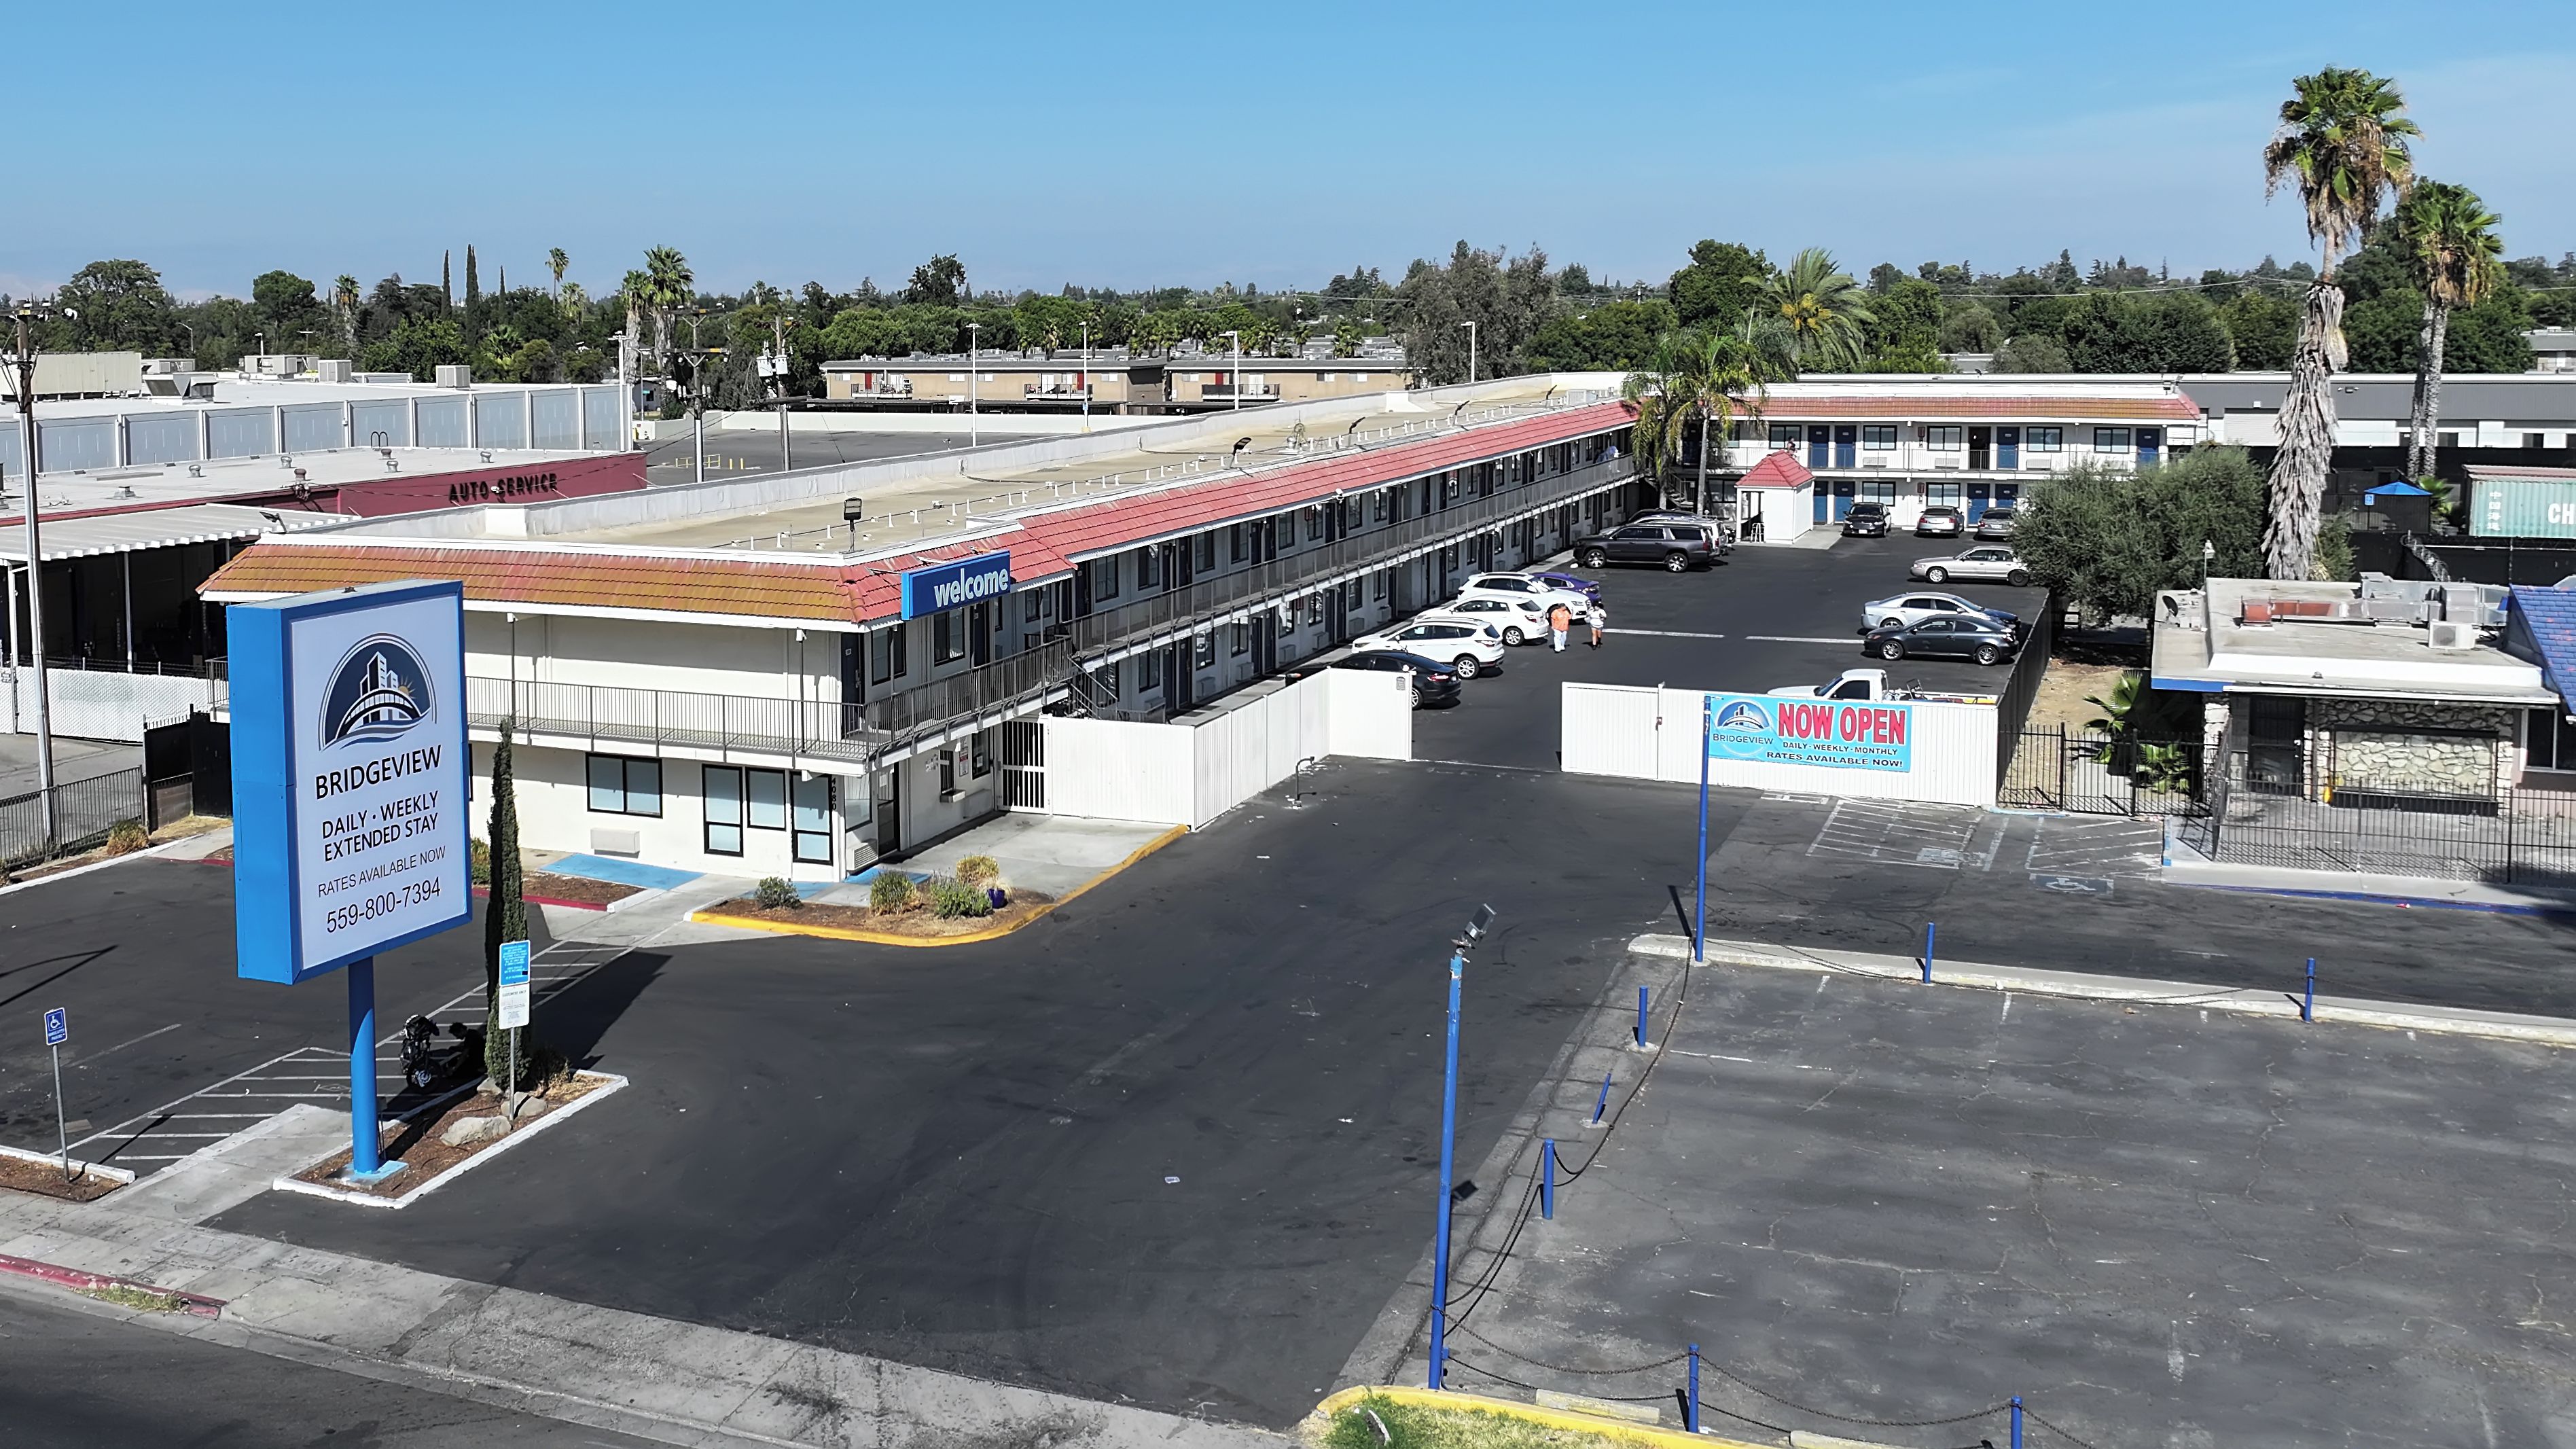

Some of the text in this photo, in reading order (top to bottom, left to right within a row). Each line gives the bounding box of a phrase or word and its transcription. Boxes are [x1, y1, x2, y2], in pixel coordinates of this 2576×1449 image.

[449, 473, 558, 501] AUTO SERVICE
[934, 568, 1009, 607] welcome
[1713, 734, 1774, 745] BRIDGEVIEW
[1778, 703, 1906, 745] NOW OPEN
[1766, 751, 1903, 767] RATES AVAILABLE NOW!
[1813, 744, 1849, 752] WEEKLY
[1855, 747, 1898, 755] MONTHLY
[315, 745, 442, 800] BRIDGEVIEW
[323, 790, 439, 840] DAILY WEEKLY
[324, 812, 439, 862] EXTENDED STAY
[318, 846, 446, 897] RATES AVAILABLE NOW
[327, 876, 441, 934] 559-800-7394
